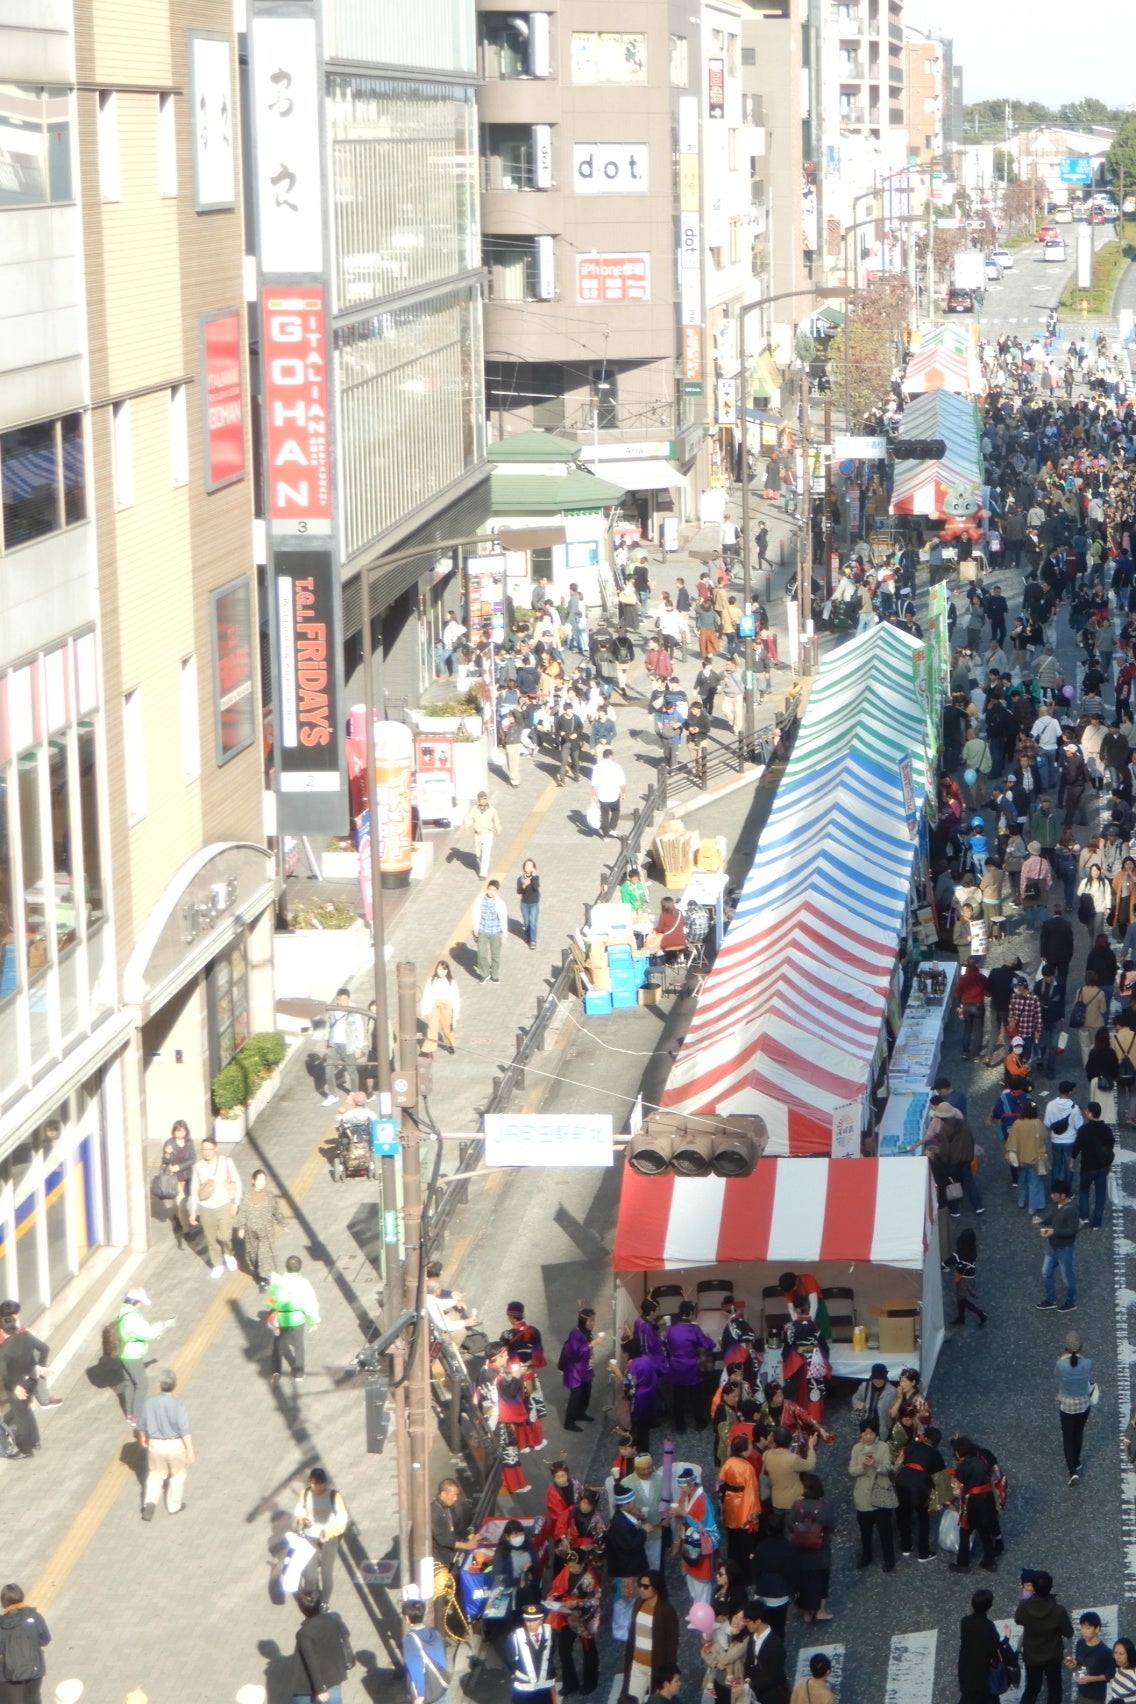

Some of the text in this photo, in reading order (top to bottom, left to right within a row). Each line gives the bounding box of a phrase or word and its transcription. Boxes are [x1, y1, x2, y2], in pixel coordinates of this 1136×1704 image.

[305, 316, 326, 434] ITALIAN
[270, 315, 310, 508] GOHAN
[297, 520, 308, 534] 3
[305, 775, 316, 788] 2
